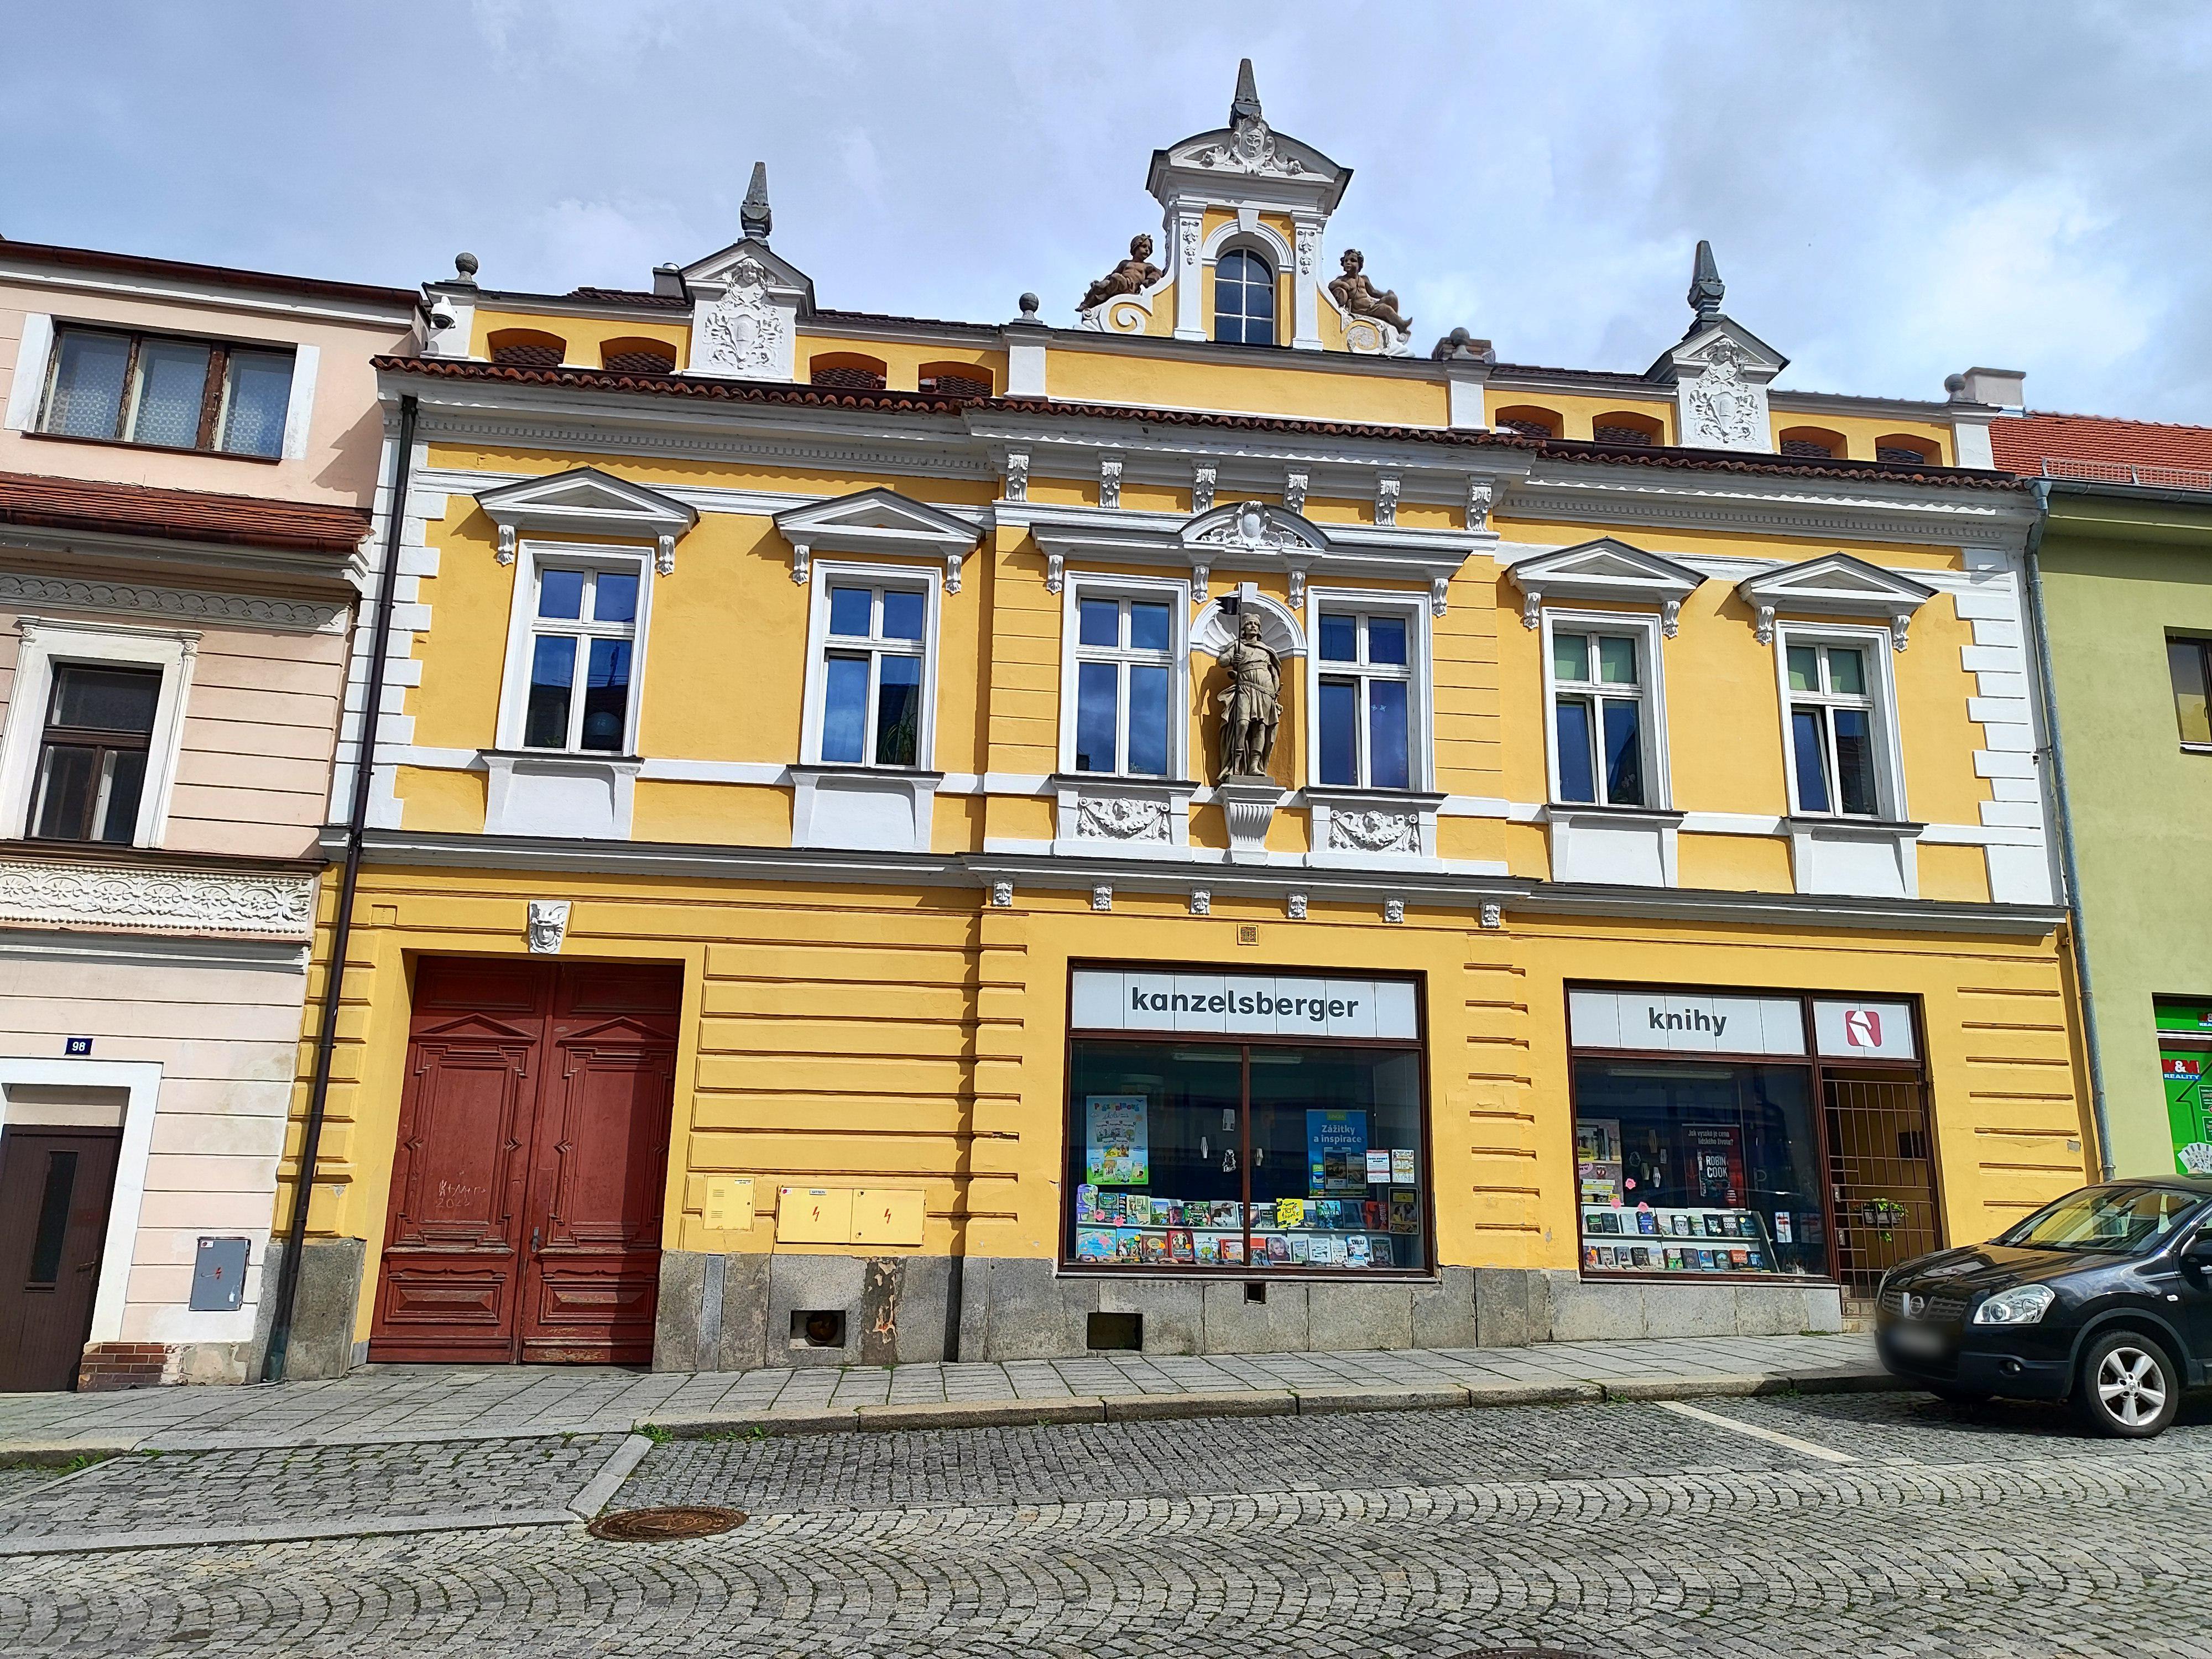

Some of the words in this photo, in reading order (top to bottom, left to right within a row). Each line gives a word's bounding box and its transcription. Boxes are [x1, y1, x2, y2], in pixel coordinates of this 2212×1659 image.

[1132, 987, 1359, 1022] kanzelsberger
[1648, 1007, 1727, 1037] knihy
[72, 1041, 86, 1051] 98
[1322, 1124, 1355, 1135] Zážitky
[1322, 1135, 1362, 1144] inspirace
[1705, 1156, 1726, 1166] ROBIN
[1707, 1167, 1728, 1178] COOK
